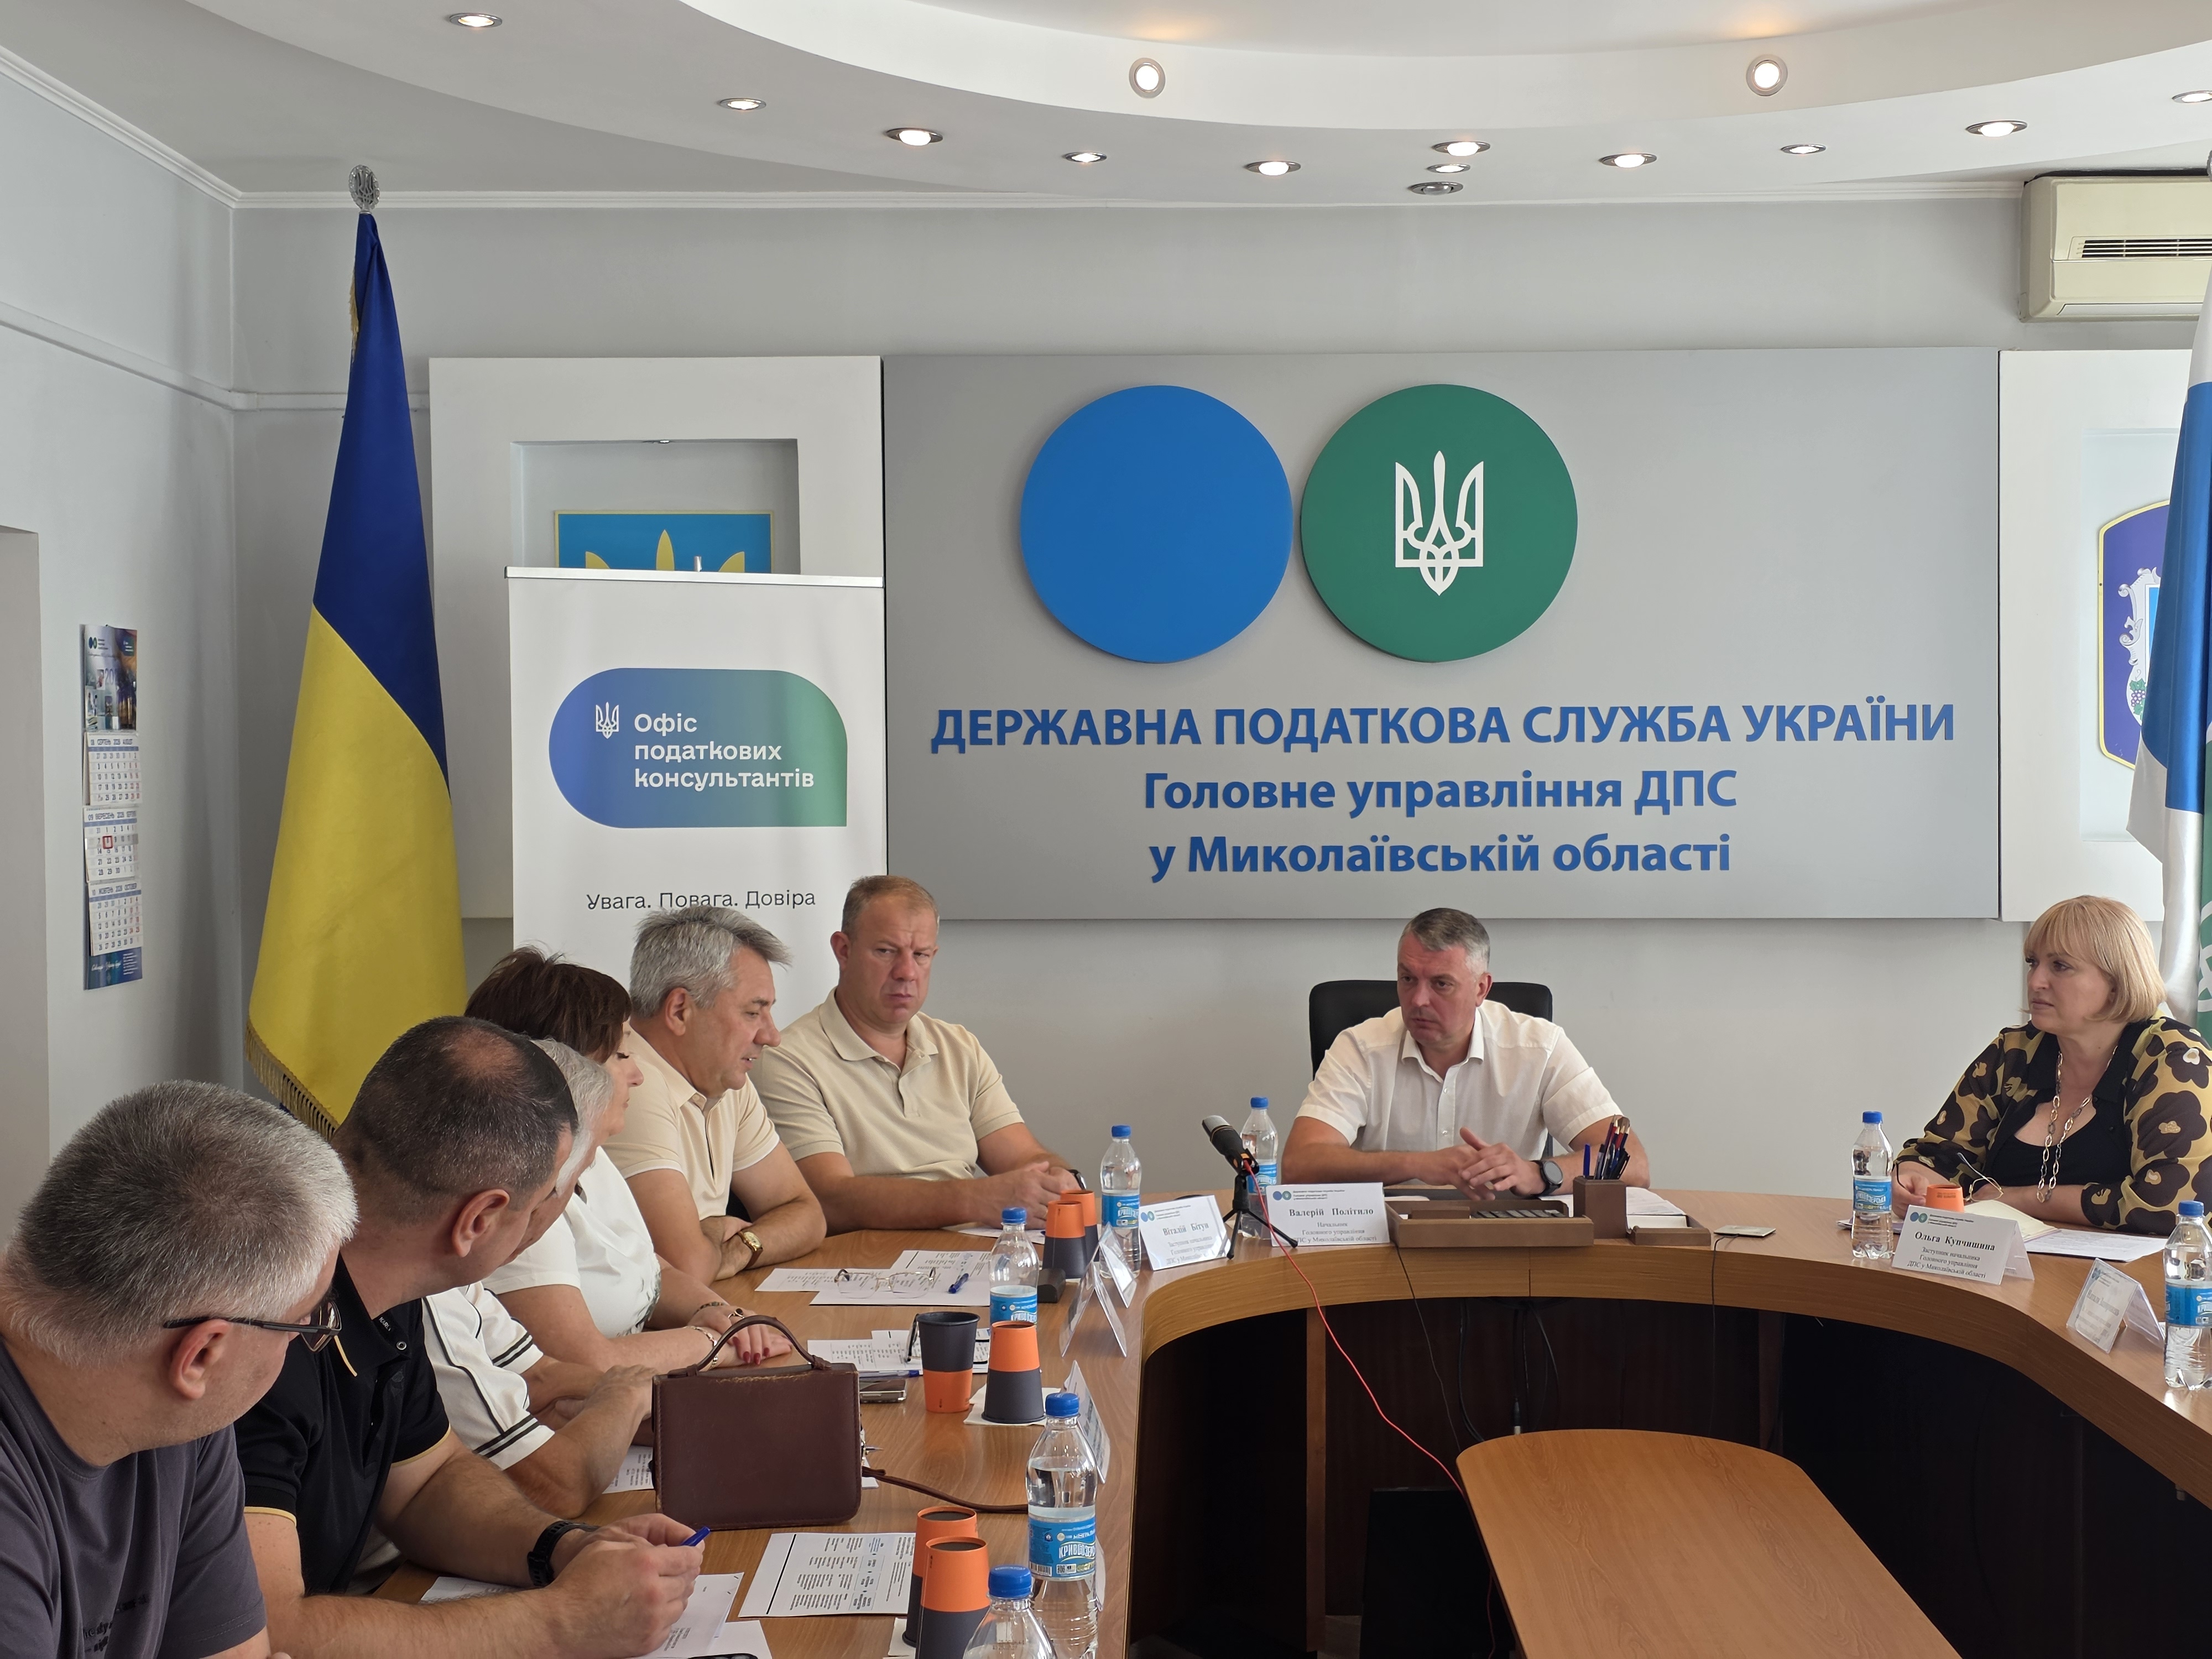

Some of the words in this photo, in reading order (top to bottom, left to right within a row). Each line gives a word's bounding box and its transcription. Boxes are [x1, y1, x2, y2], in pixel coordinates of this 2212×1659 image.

[634, 713, 697, 737] Офіс
[931, 708, 1201, 754] ДЕРЖАВНА
[1215, 707, 1510, 753] ПОДАТКОВА
[1523, 706, 1731, 743] СЛУЖБА
[1742, 695, 1954, 742] УКРАЇНИ
[635, 741, 782, 763] податкових
[635, 769, 814, 791] консультантів
[1145, 773, 1335, 809] Головне
[1346, 770, 1621, 818] управління
[1635, 769, 1738, 816] ДПС
[1149, 846, 1176, 883] у
[1188, 834, 1539, 872] Миколаївській
[1553, 832, 1730, 871] області
[586, 894, 651, 910] Увага.
[660, 893, 738, 908] Повага.
[745, 890, 816, 909] Довіра
[1289, 1208, 1324, 1218] Валерій
[1163, 1225, 1187, 1235] Віталій
[1915, 1232, 1940, 1243] Ольга
[1945, 1236, 1995, 1251] Купчишина
